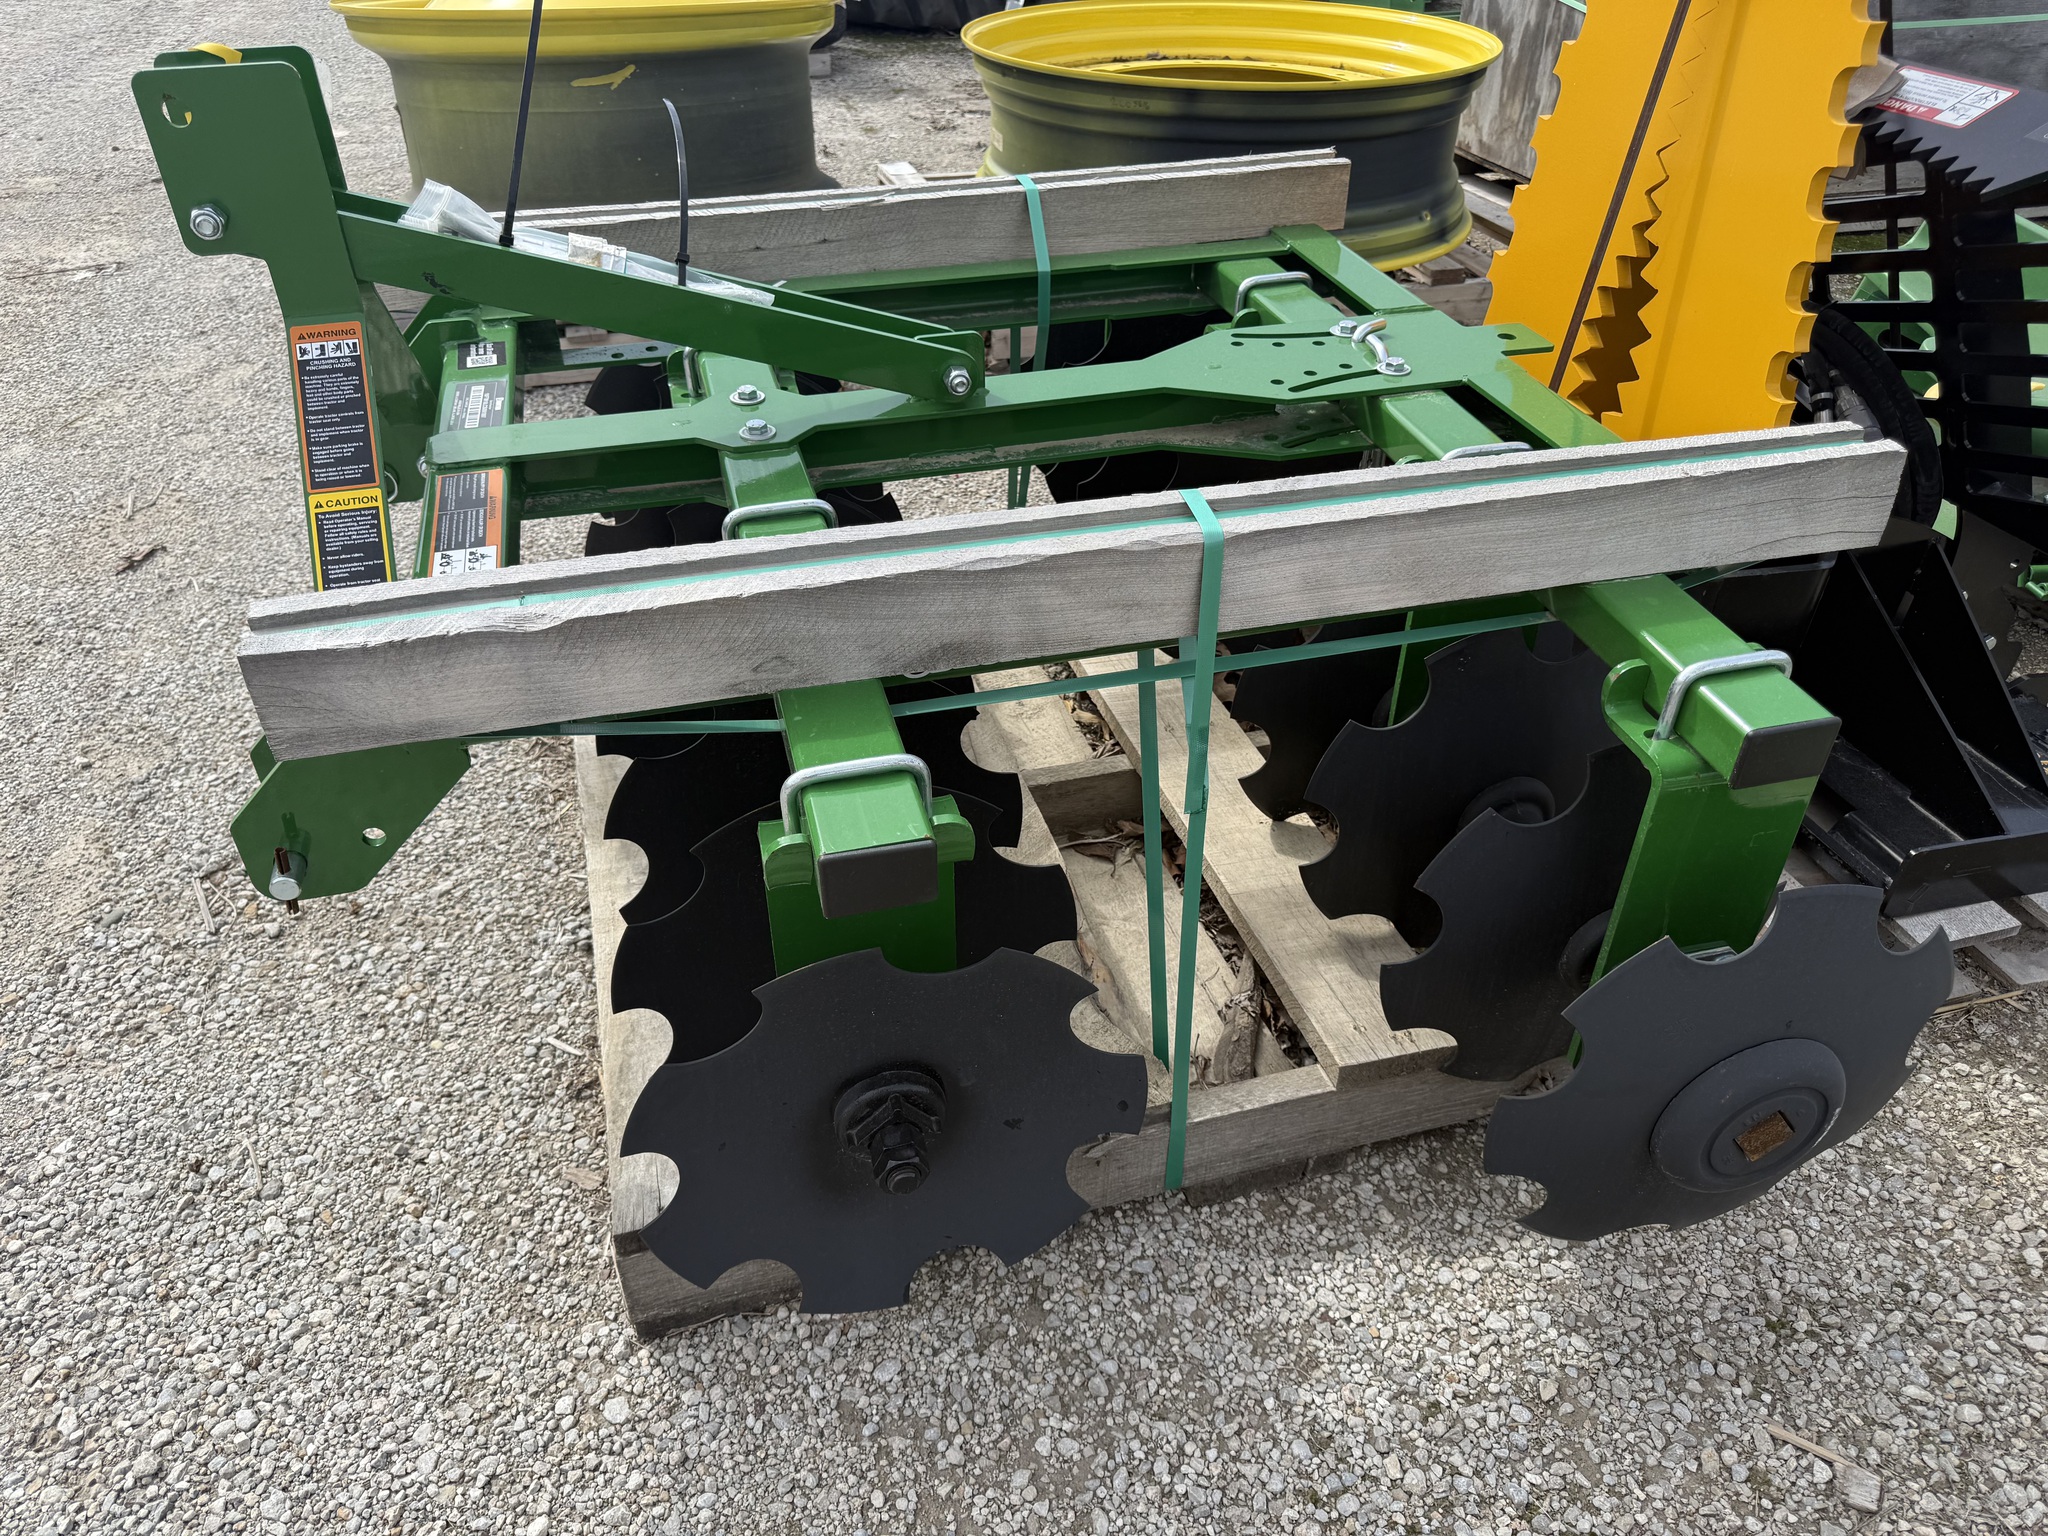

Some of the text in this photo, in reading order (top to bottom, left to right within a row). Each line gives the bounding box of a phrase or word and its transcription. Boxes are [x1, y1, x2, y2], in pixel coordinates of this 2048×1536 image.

[1883, 98, 1918, 112] DANG
[306, 329, 356, 339] WARNING
[326, 496, 378, 507] CAUTION
